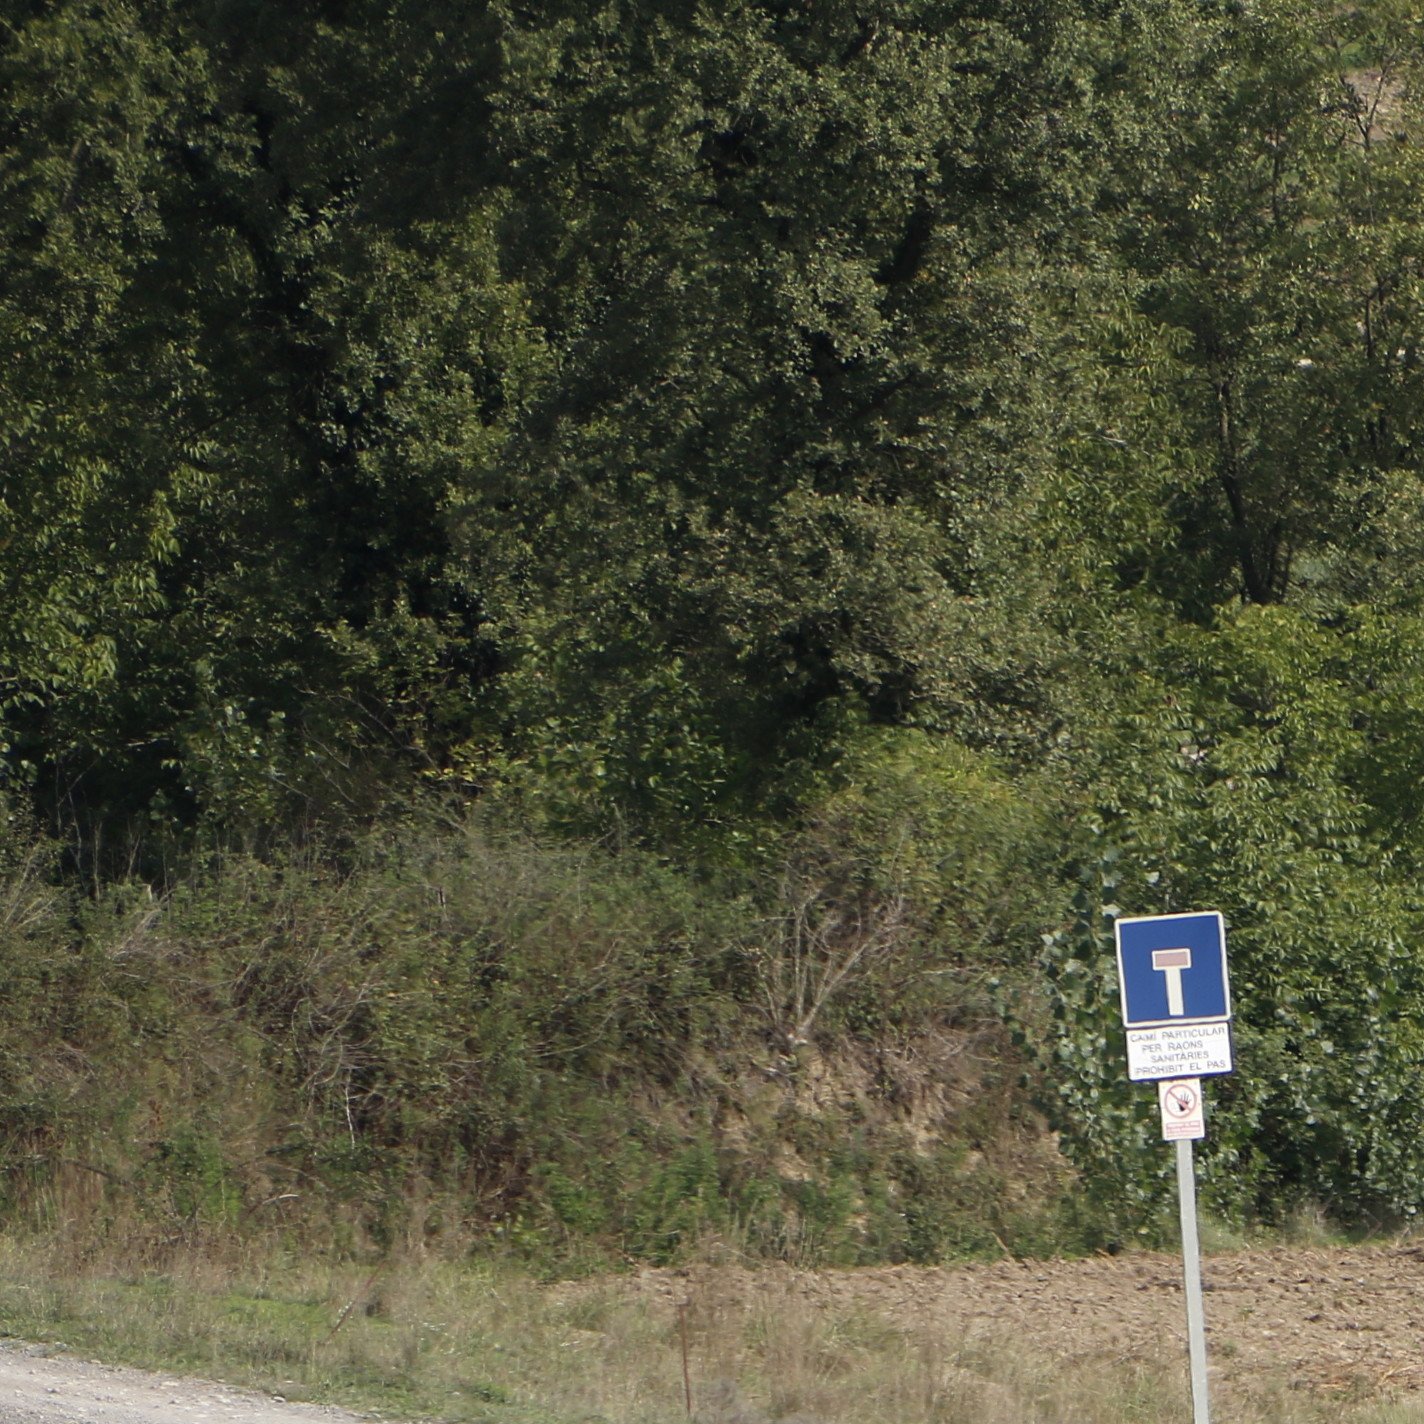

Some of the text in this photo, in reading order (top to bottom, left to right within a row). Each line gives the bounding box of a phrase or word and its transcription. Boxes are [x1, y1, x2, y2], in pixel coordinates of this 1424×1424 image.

[1162, 1027, 1225, 1039] PARTICULAR
[1142, 1040, 1203, 1052] PER RAONS
[1136, 1059, 1226, 1075] PROHIBIT EL PAS
